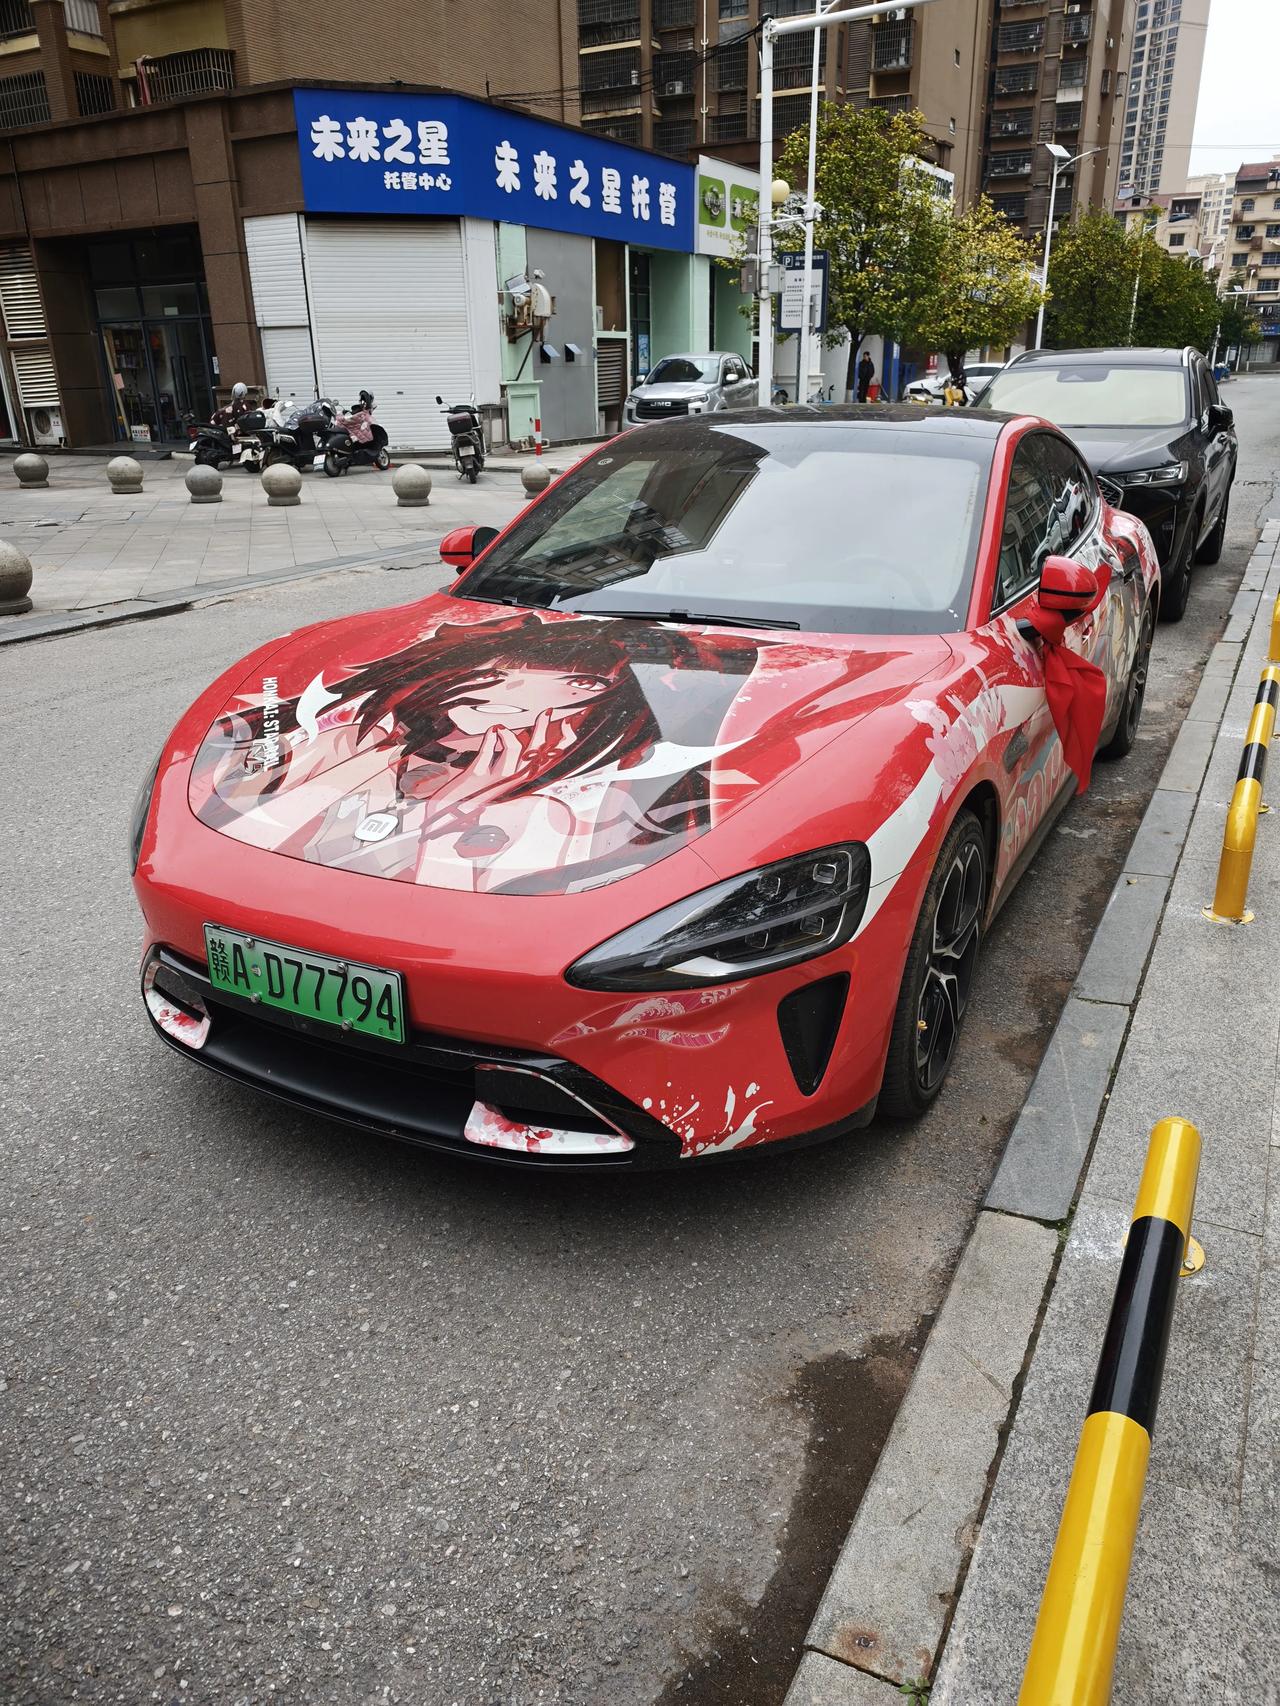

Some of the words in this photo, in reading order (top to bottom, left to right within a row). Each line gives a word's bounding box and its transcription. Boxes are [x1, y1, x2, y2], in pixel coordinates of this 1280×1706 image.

[310, 114, 451, 166] 未来之星
[383, 171, 452, 191] 托管中心
[494, 140, 677, 227] 未来之星托管
